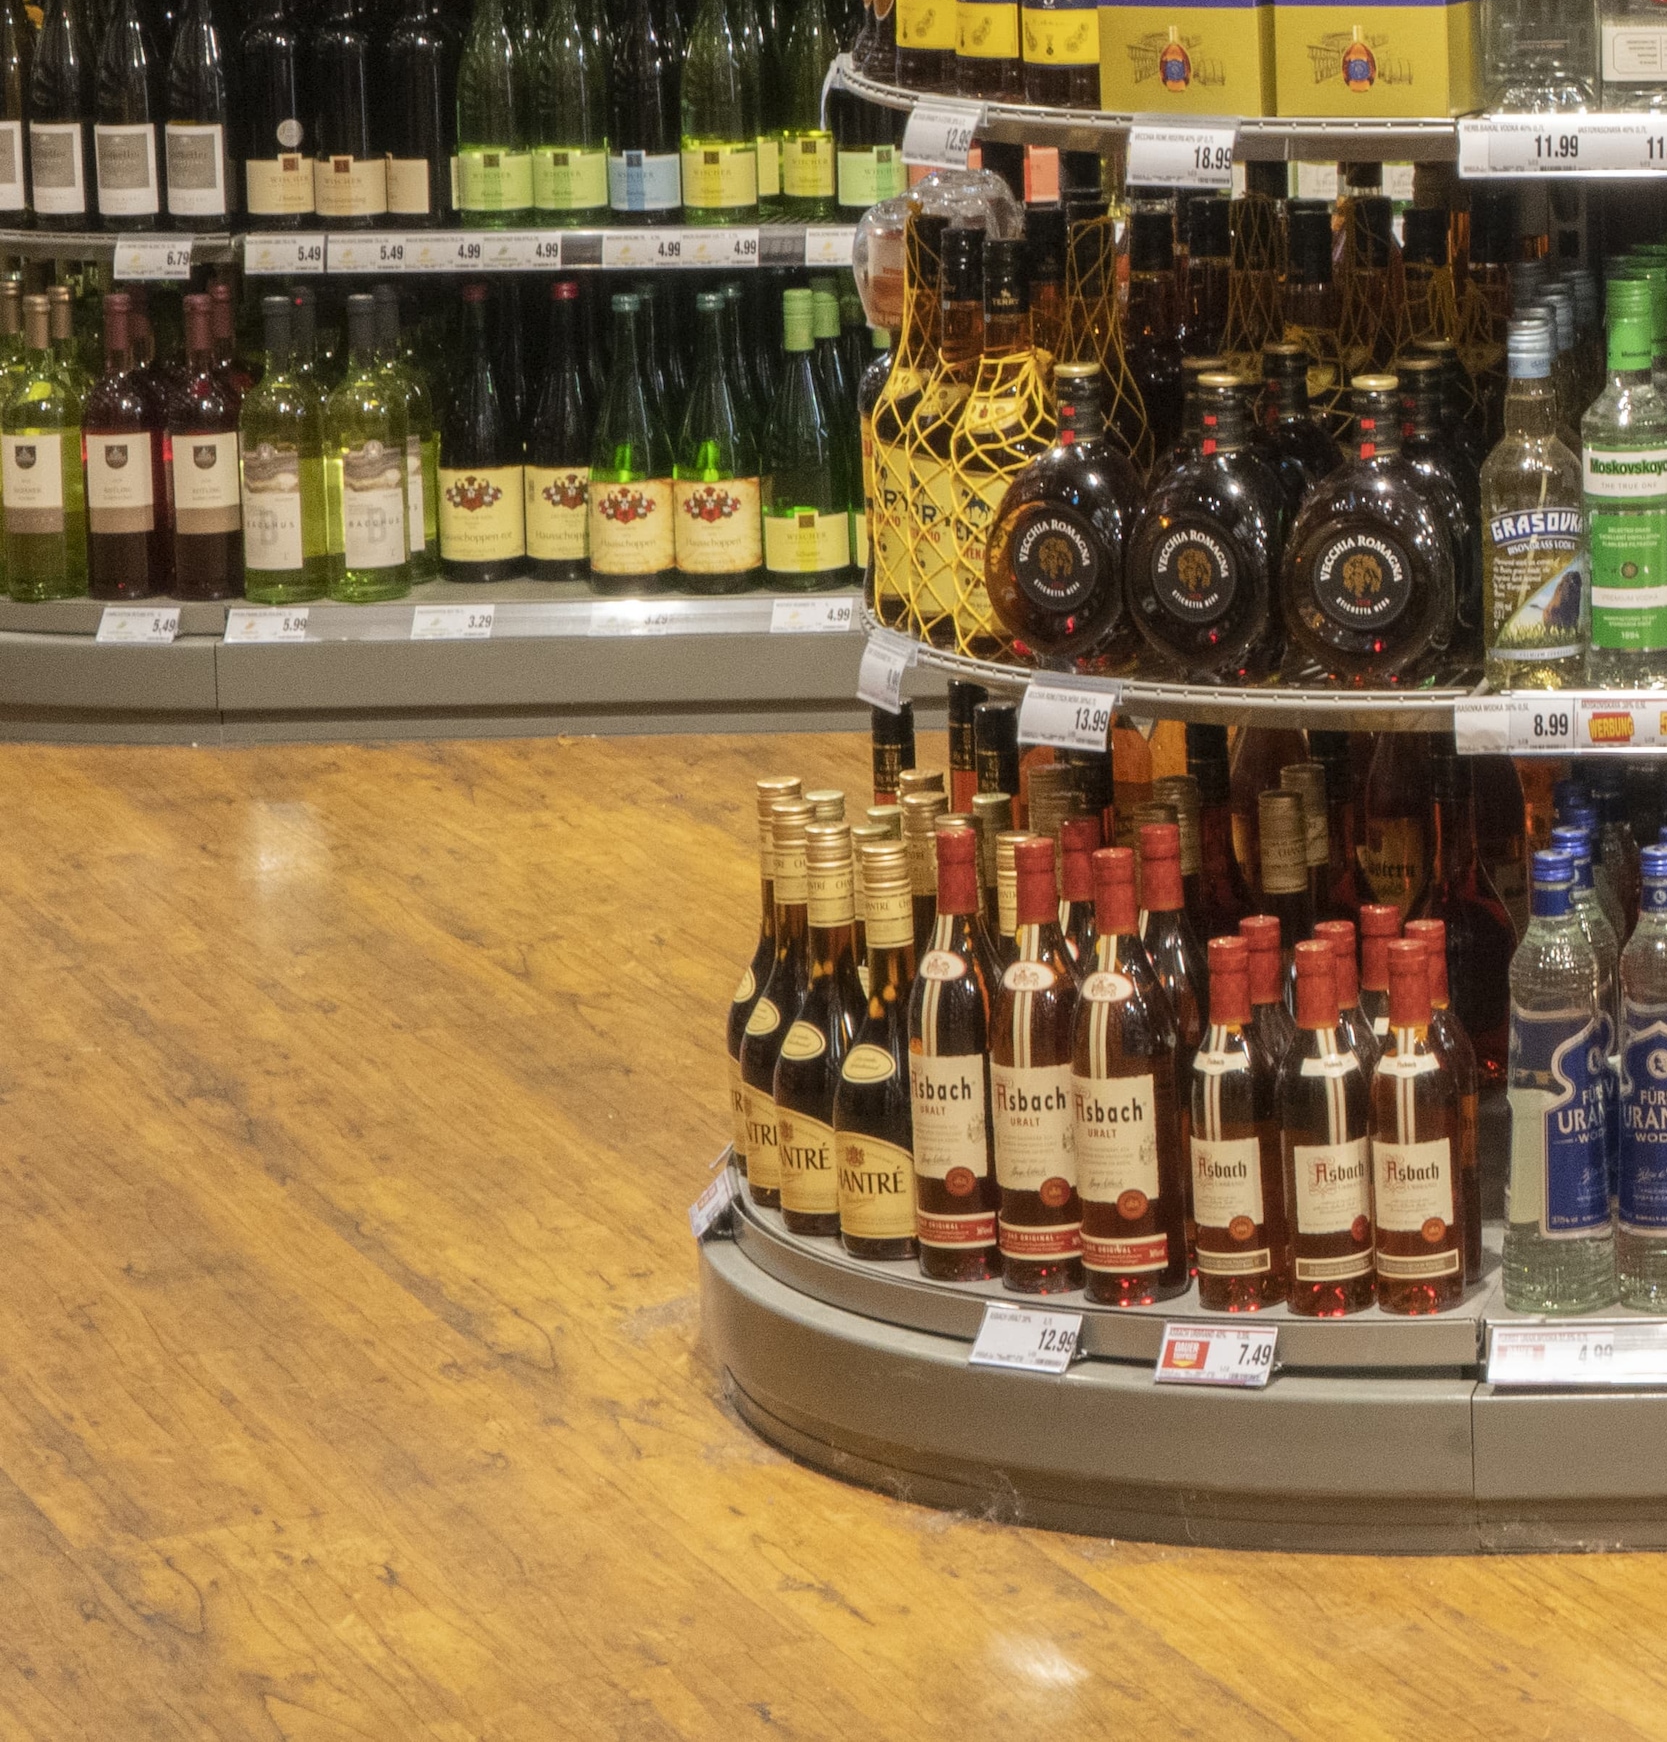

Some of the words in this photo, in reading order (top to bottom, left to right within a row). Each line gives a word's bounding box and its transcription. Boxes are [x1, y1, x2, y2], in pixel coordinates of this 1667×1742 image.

[1535, 136, 1579, 158] 11.99
[298, 245, 322, 262] 5.49
[535, 242, 560, 258] 4.99
[1600, 482, 1616, 490] THE
[1620, 482, 1639, 490] TRUE
[1642, 482, 1658, 490] ONE
[1320, 537, 1356, 582] VECCHIA
[1357, 535, 1403, 583] ROMAGNA
[468, 614, 492, 630] 3.29
[1534, 715, 1568, 736] 8.99
[1588, 716, 1634, 739] WERBUNG
[996, 1080, 1066, 1116] Asbach
[1074, 1092, 1145, 1127] Asbach
[1239, 1342, 1272, 1368] 7.49
